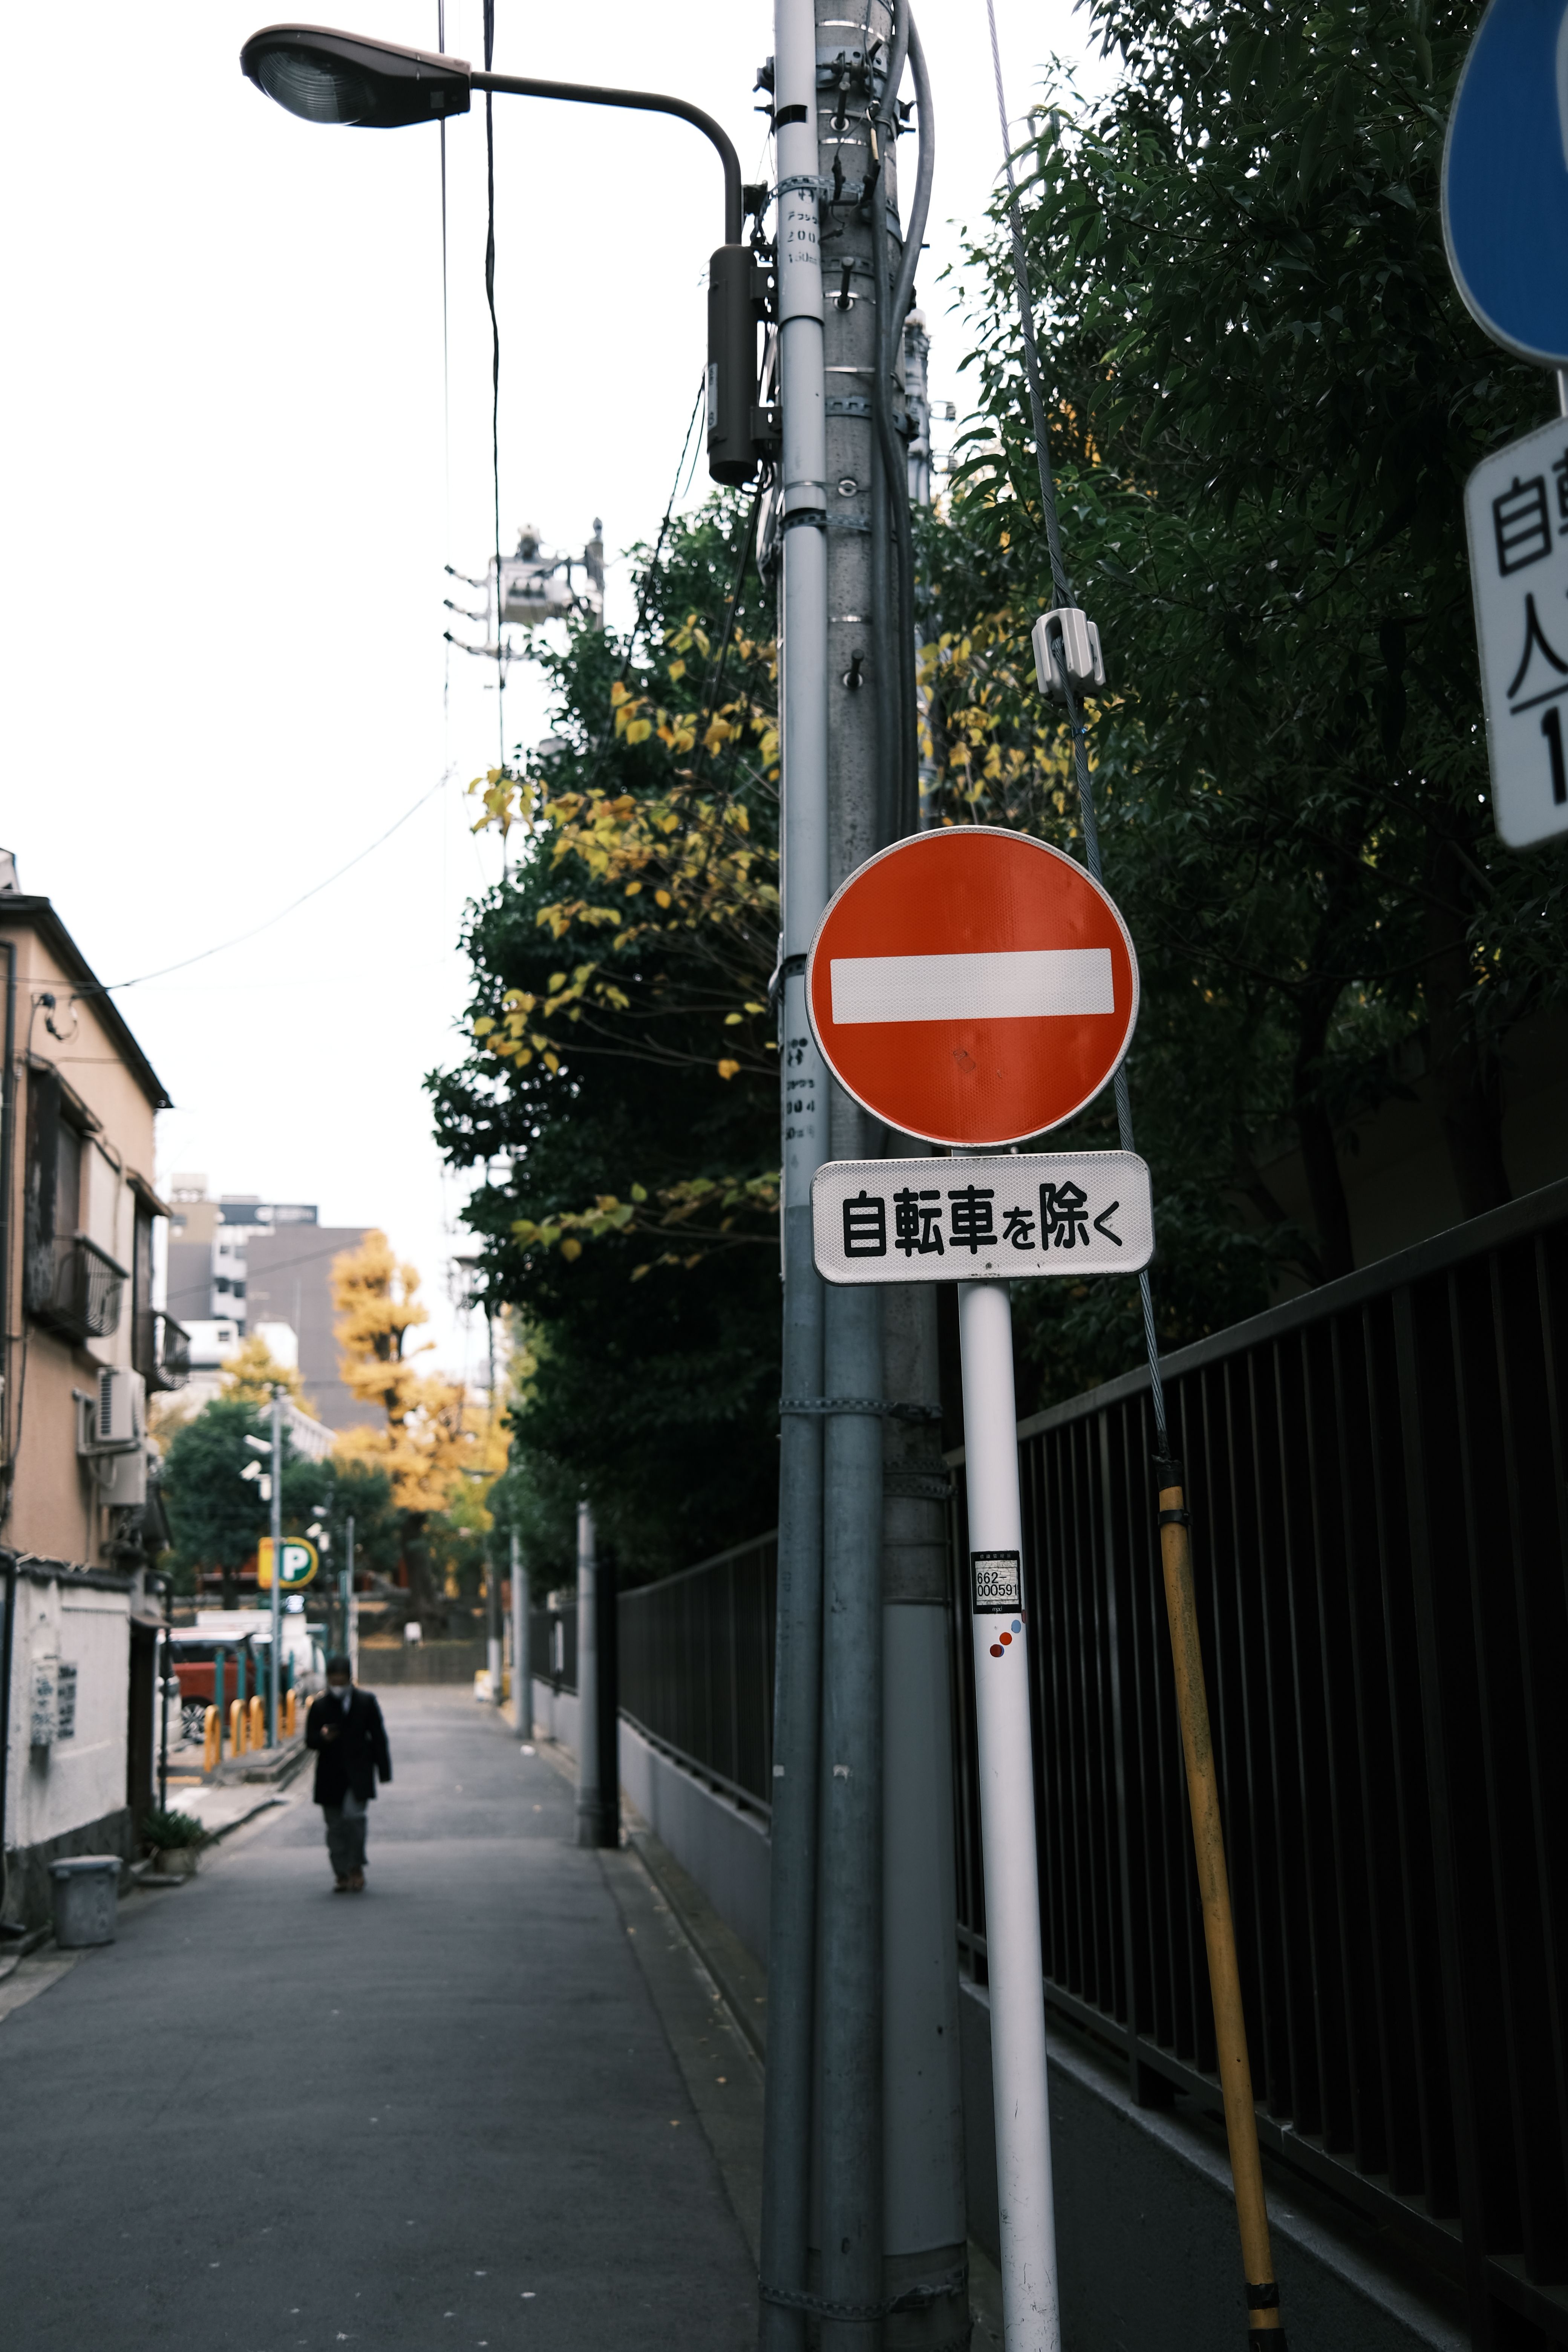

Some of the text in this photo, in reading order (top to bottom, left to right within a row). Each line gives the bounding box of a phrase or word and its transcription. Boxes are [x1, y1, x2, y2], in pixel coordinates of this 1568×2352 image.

[843, 1180, 1123, 1258] 自転車を除く
[283, 1546, 309, 1581] P
[977, 1572, 1007, 1584] 662-
[978, 1584, 1017, 1597] 000591
